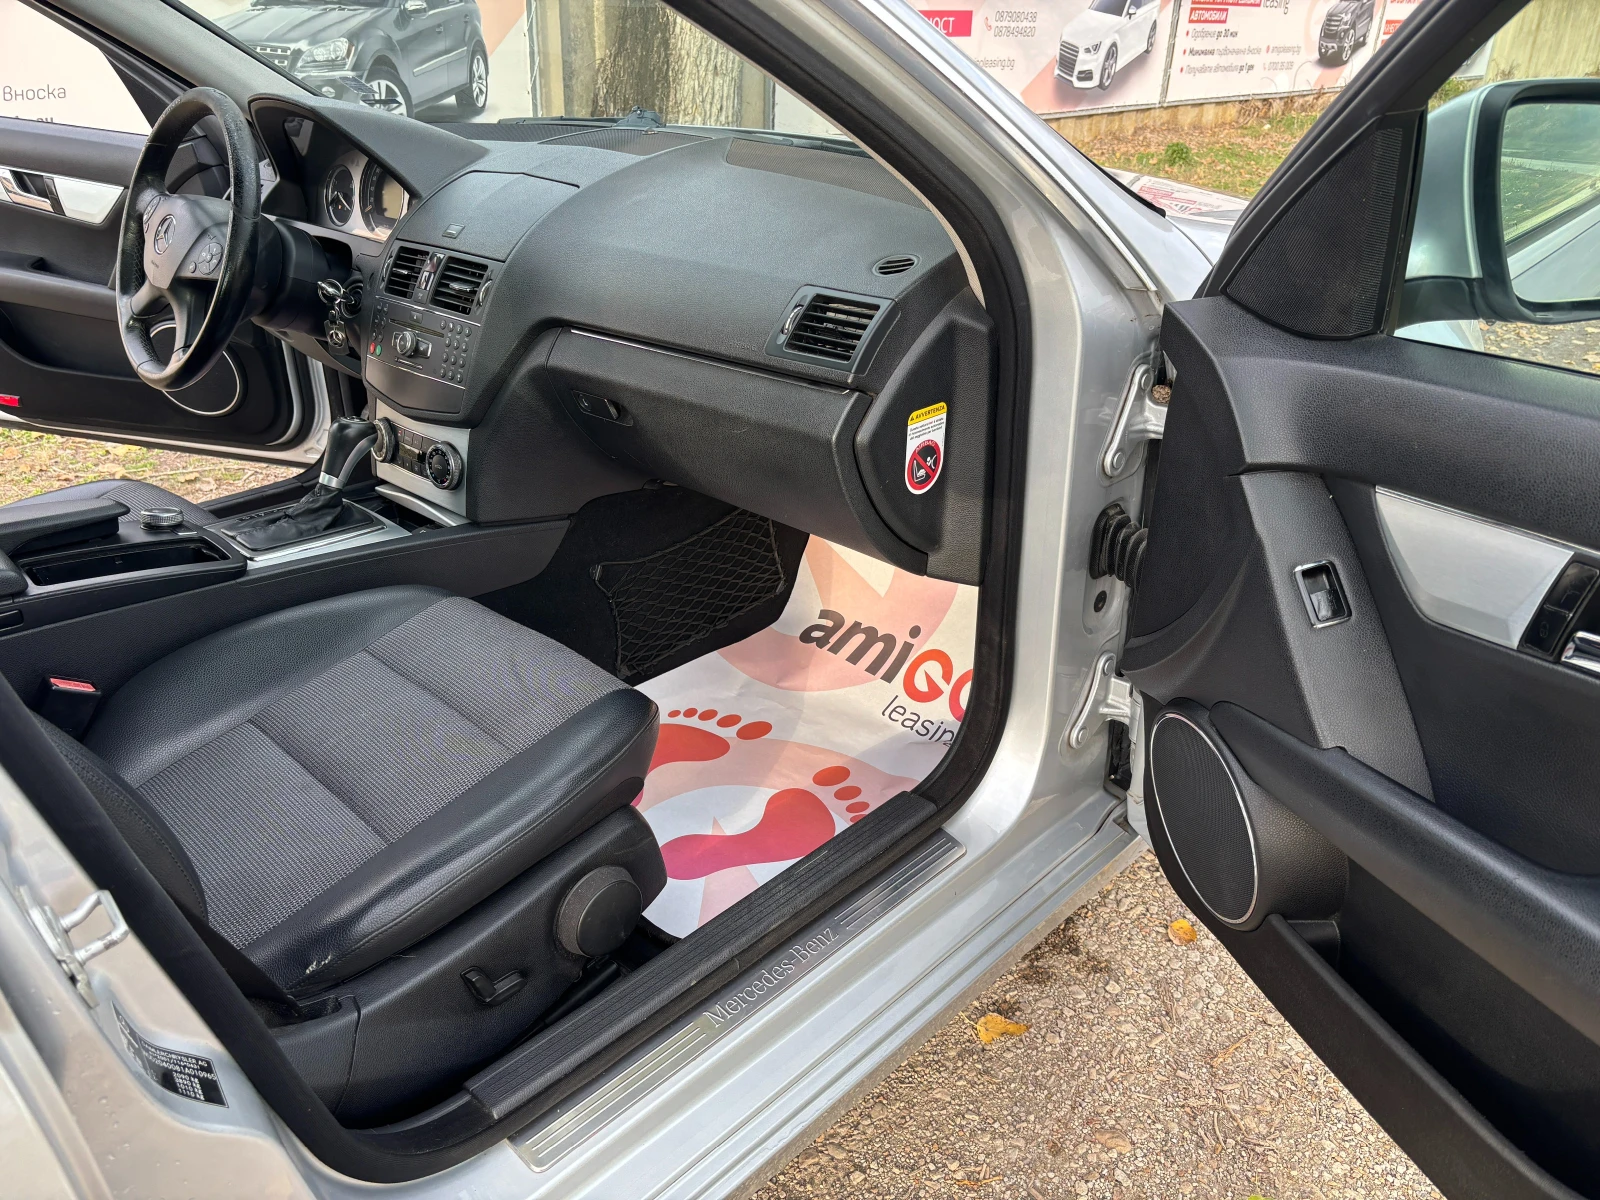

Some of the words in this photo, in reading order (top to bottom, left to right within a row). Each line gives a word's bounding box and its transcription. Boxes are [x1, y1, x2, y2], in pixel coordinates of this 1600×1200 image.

[995, 10, 1037, 23] 0879080438
[1190, 10, 1228, 21] АВТОМОБИЛИ
[994, 26, 1036, 37] 0878494820
[916, 405, 945, 420] AVVERTENZA
[881, 695, 955, 748] leasin
[703, 927, 840, 1028] Mercedes-Benz
